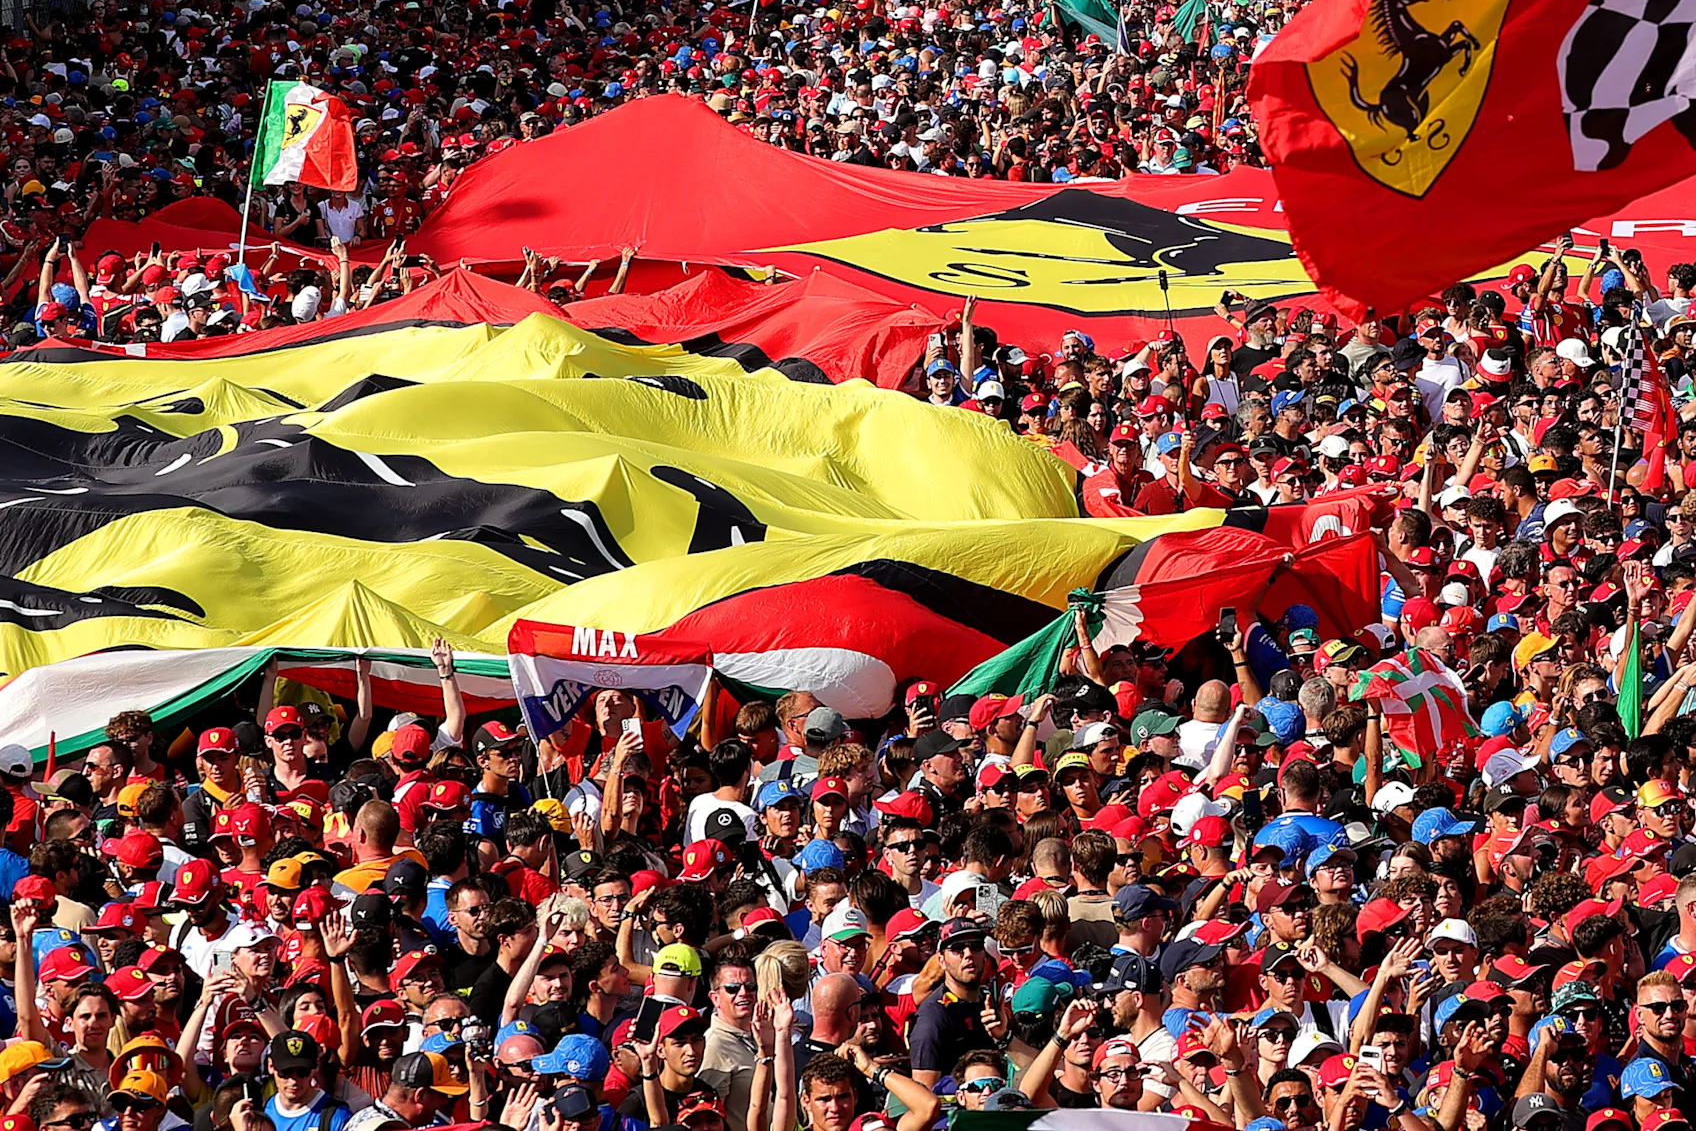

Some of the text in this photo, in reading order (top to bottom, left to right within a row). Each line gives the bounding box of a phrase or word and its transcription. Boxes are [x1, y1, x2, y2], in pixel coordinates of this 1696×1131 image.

[571, 627, 639, 659] MAX
[541, 679, 685, 723] VEREN
[1528, 1095, 1544, 1108] NY
